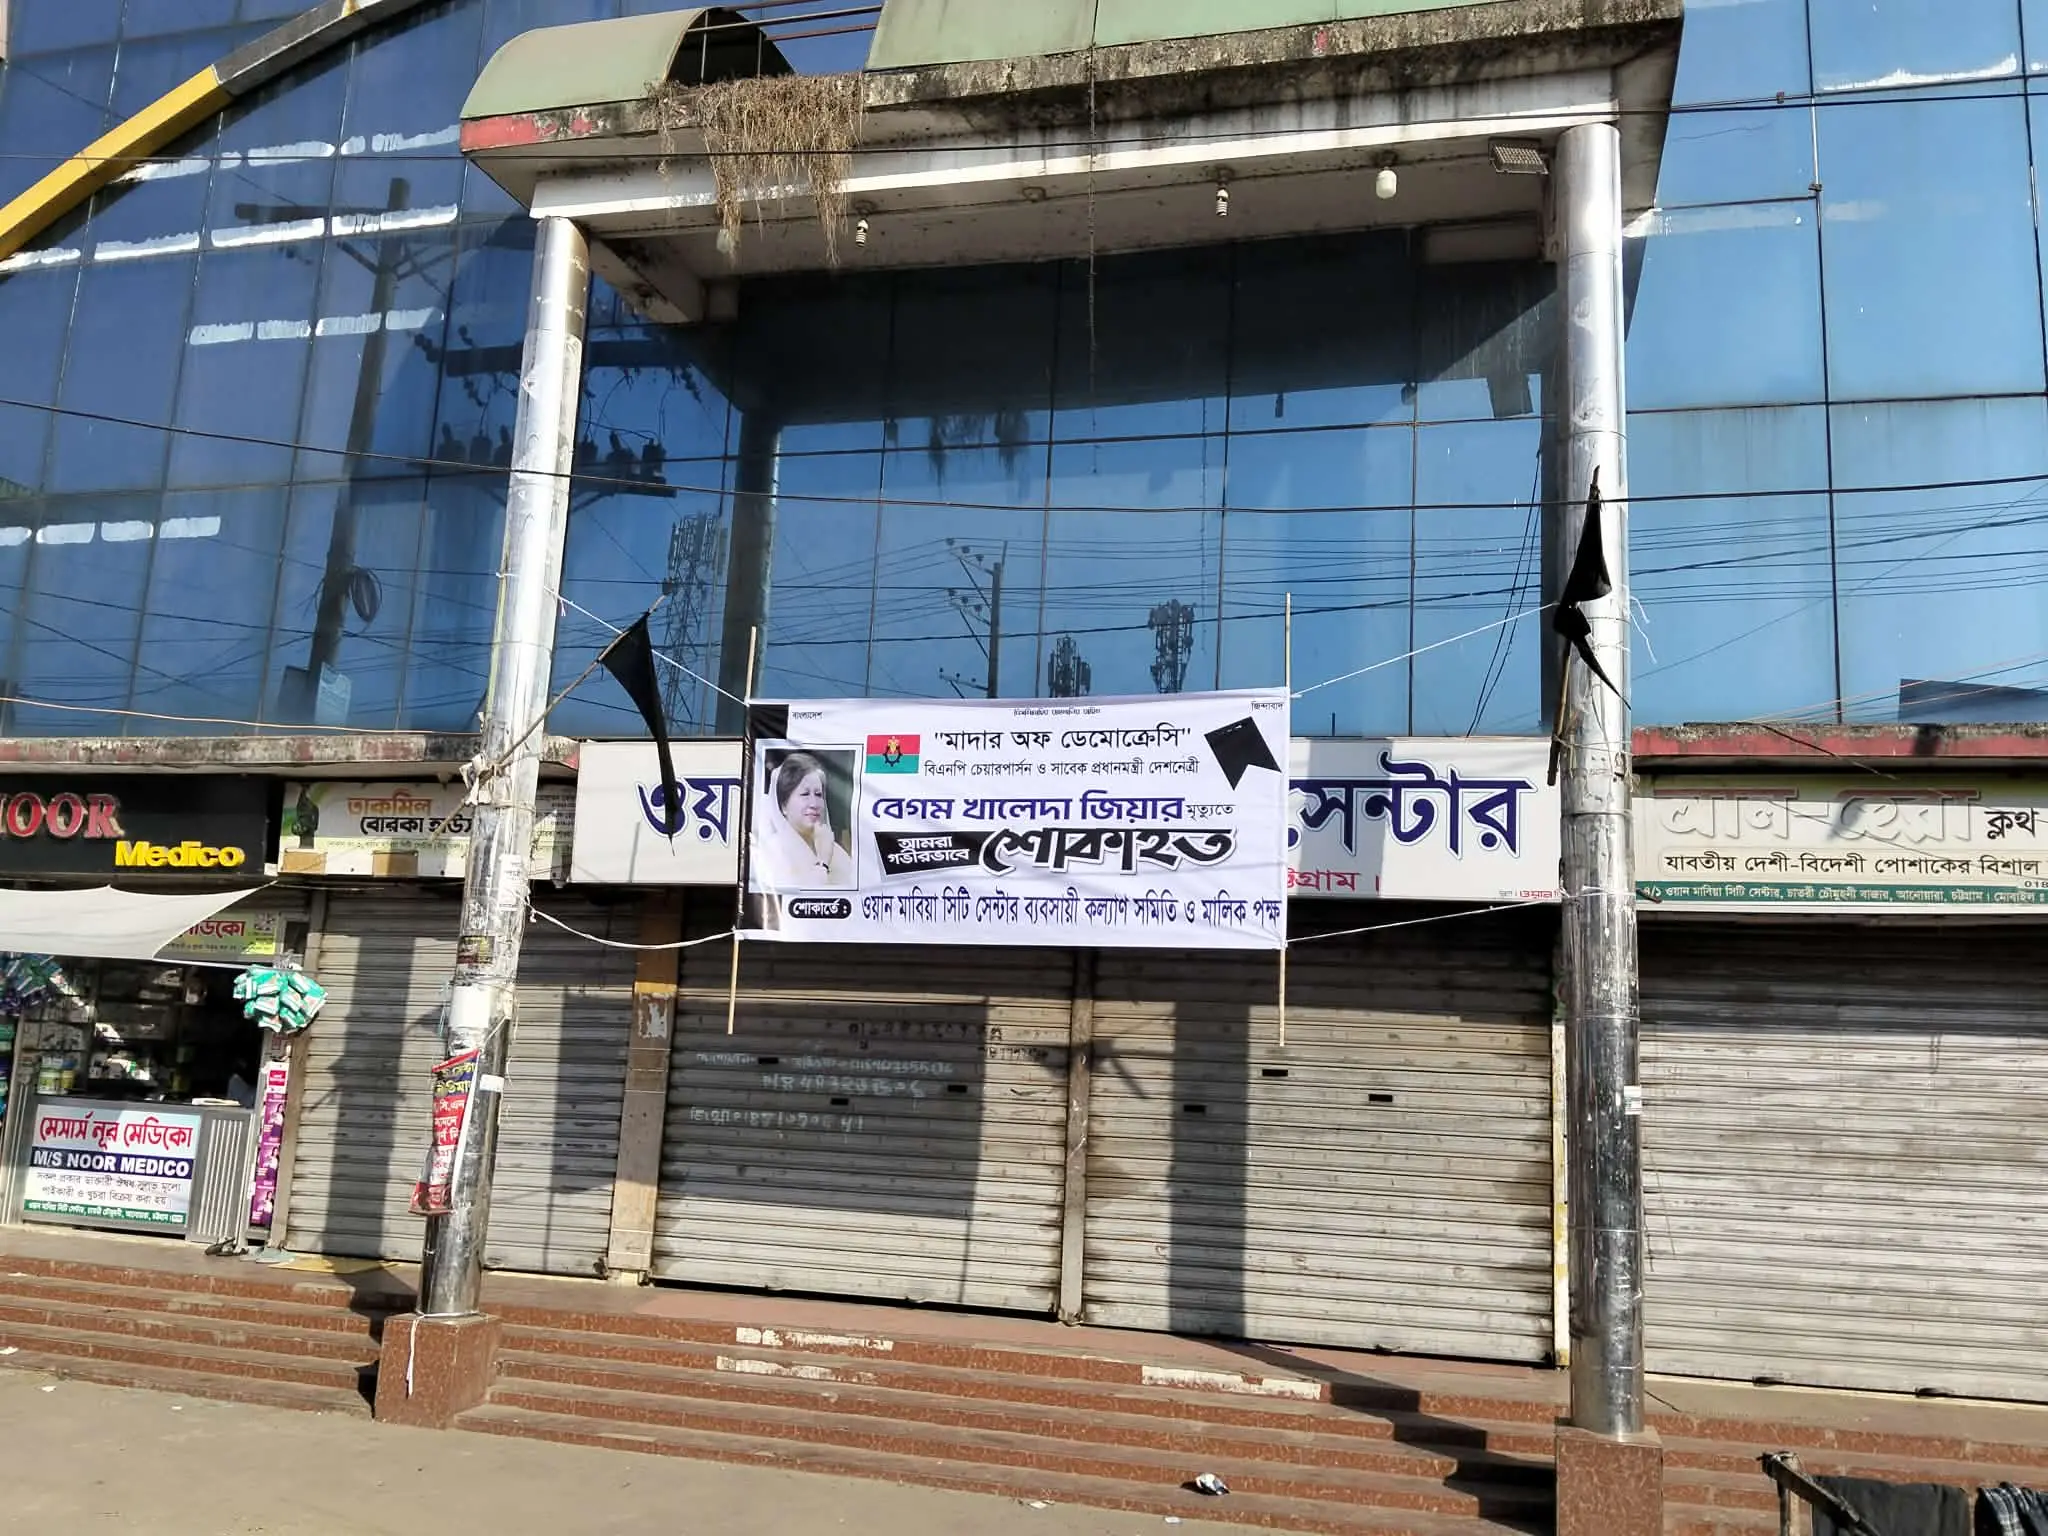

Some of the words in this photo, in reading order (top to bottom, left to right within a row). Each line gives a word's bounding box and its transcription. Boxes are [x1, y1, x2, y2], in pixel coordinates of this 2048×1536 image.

[792, 710, 823, 720] বাংলাদেশ
[1011, 730, 1052, 749] অফ
[924, 760, 967, 777] বিএনপি
[970, 758, 1033, 777] চেয়ারপার্সন
[1037, 764, 1046, 775] ও
[1051, 762, 1087, 775] সাবেক
[1091, 757, 1143, 775] প্রধানমন্ত্রী
[1148, 755, 1200, 775] দেশনেত্রী
[0, 793, 125, 838] OOR
[347, 788, 433, 816] তাকমিল
[872, 798, 955, 820] বেগম
[962, 797, 1073, 820] খালেদা
[1079, 789, 1186, 823] জিয়ার
[1186, 804, 1236, 822] মৃত্যুতে
[360, 816, 424, 835] বোরকা
[1984, 808, 2040, 840] ক্লথ
[115, 840, 245, 867] Medico
[887, 847, 971, 865] গভীরভাবে
[897, 836, 953, 849] আমরা
[979, 826, 1237, 877] শোকাহত
[1665, 850, 1737, 872] যাবতীয়
[1744, 851, 1867, 874] দেশী-বিদেশী
[1875, 857, 1972, 875] পোশাকের
[1980, 854, 2041, 876] বিশাল
[792, 899, 840, 916] শোকার্তে
[862, 895, 893, 923] ওয়ান
[942, 886, 971, 925] সিটি
[975, 886, 1020, 925] সেন্টার
[1024, 887, 1080, 926] ব্যবসায়ী
[1084, 893, 1129, 926] কল্যাণ
[1133, 889, 1179, 928] সমিতি
[1184, 901, 1196, 923] ও
[1201, 889, 1248, 928] মালিক
[1253, 898, 1282, 928] পক্ষ
[40, 1111, 95, 1141] মেসার্স
[92, 1120, 119, 1150] নূর
[123, 1116, 193, 1150] মেডিকো
[33, 1150, 62, 1167] M/S
[66, 1153, 117, 1172] NOOR
[120, 1157, 190, 1178] MEDICO
